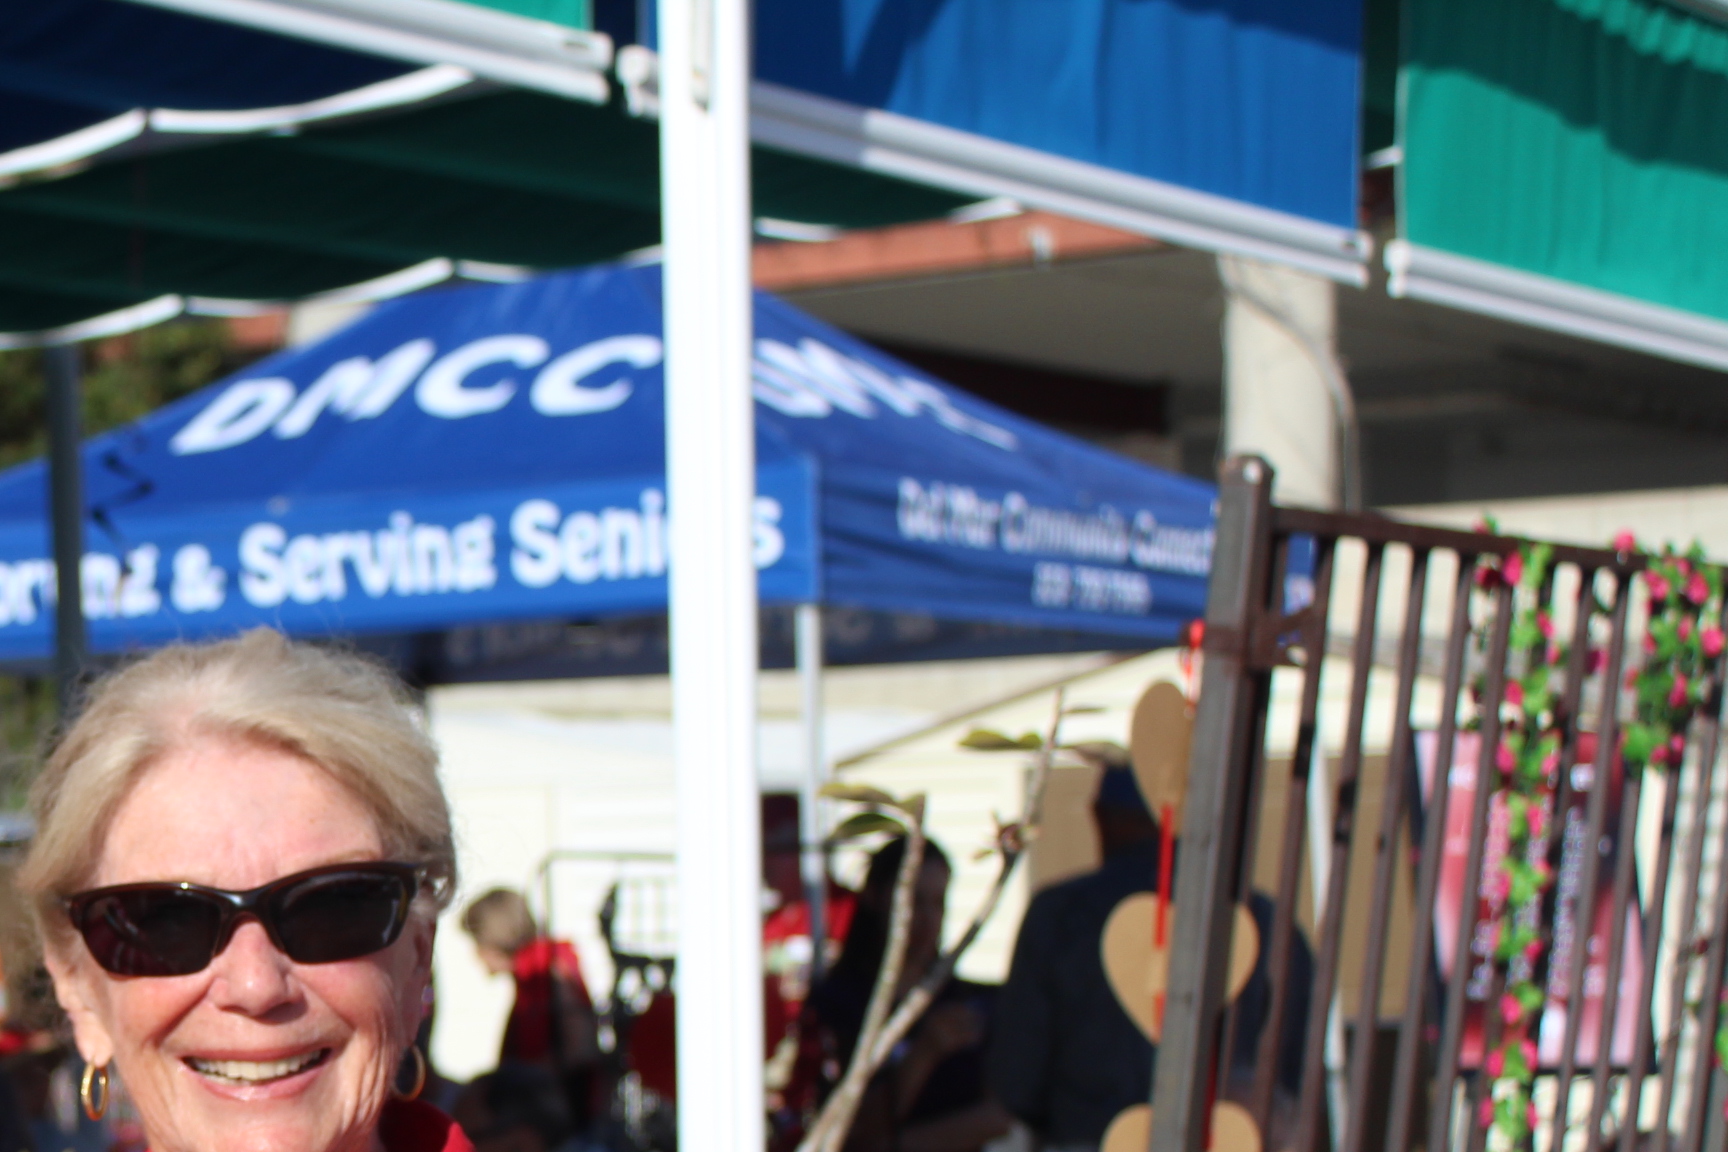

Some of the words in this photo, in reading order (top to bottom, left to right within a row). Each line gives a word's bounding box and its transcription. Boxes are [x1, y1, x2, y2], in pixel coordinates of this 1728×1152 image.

[170, 334, 664, 457] DMCC
[171, 543, 226, 615] &
[237, 511, 496, 606] Serving
[510, 489, 786, 589] Senis
